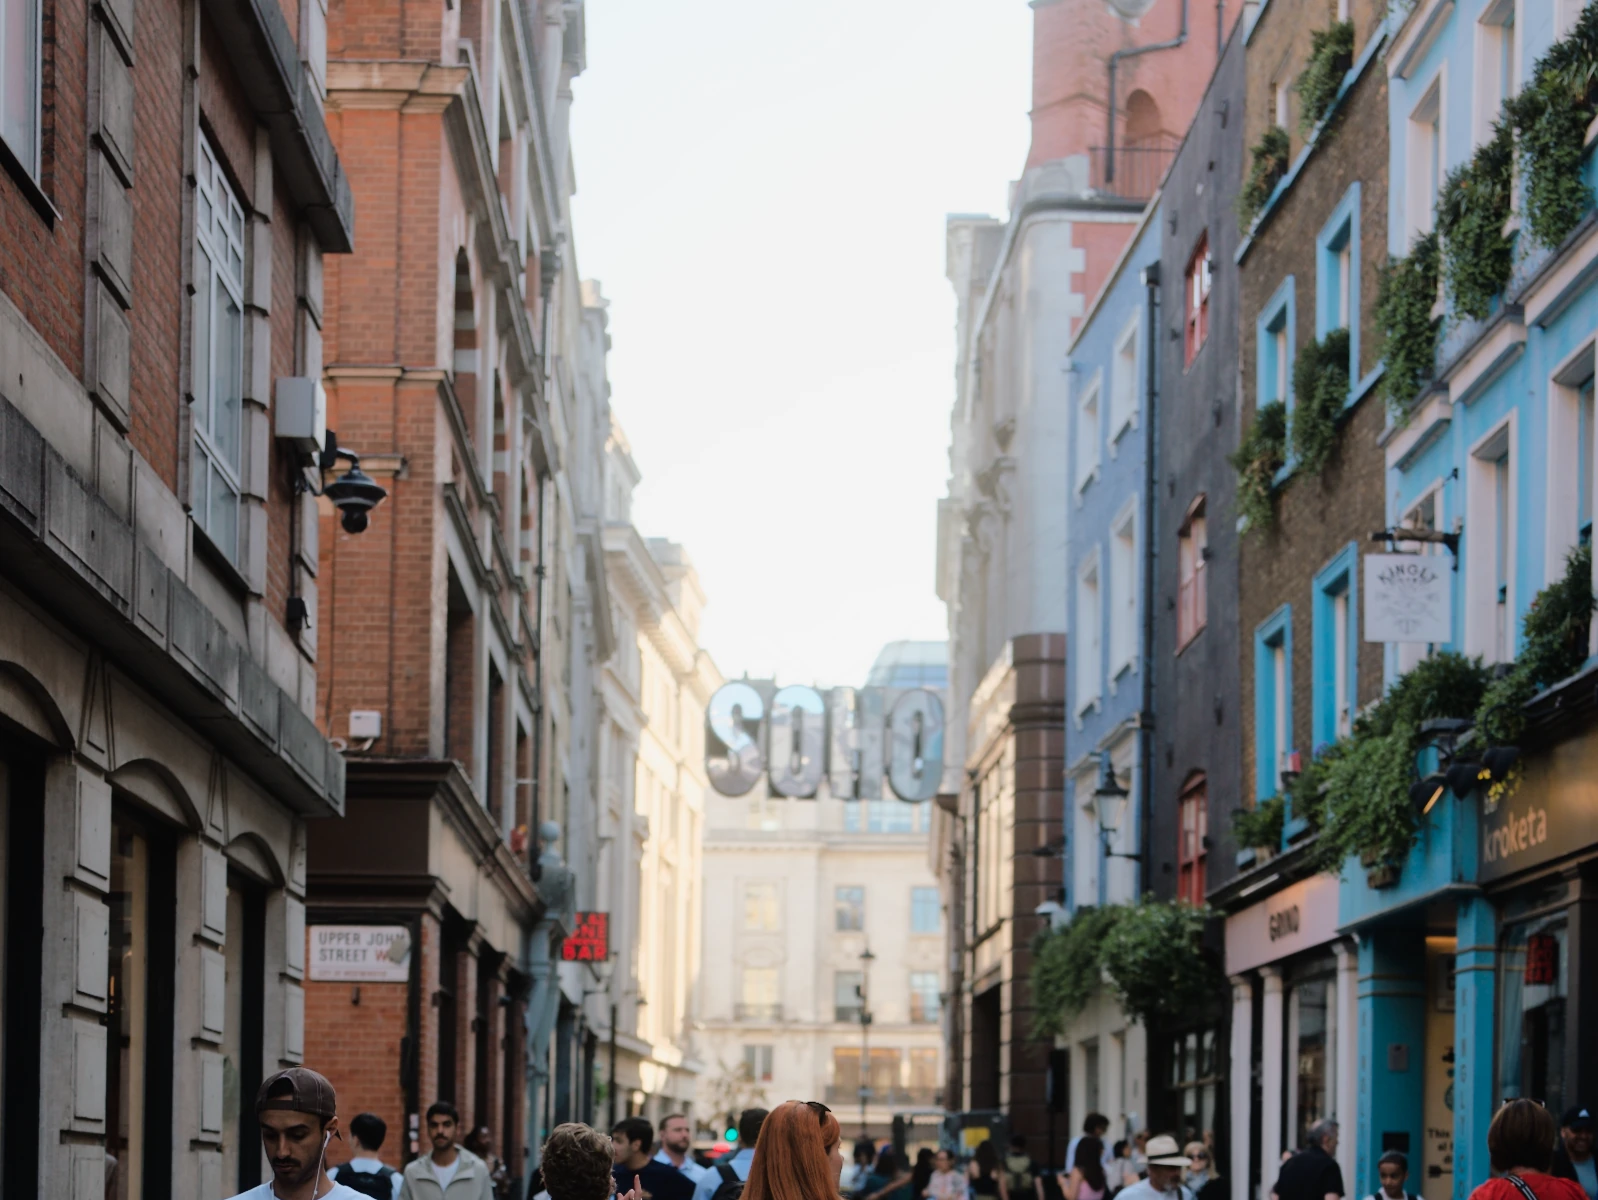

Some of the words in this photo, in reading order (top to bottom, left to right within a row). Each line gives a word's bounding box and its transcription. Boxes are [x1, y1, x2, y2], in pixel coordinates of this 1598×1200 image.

[1377, 563, 1439, 587] KINGLY
[706, 683, 945, 803] SOHO
[1483, 805, 1547, 863] kroketa
[319, 931, 361, 946] UPPER
[319, 948, 367, 962] STREET
[563, 945, 607, 960] BAR
